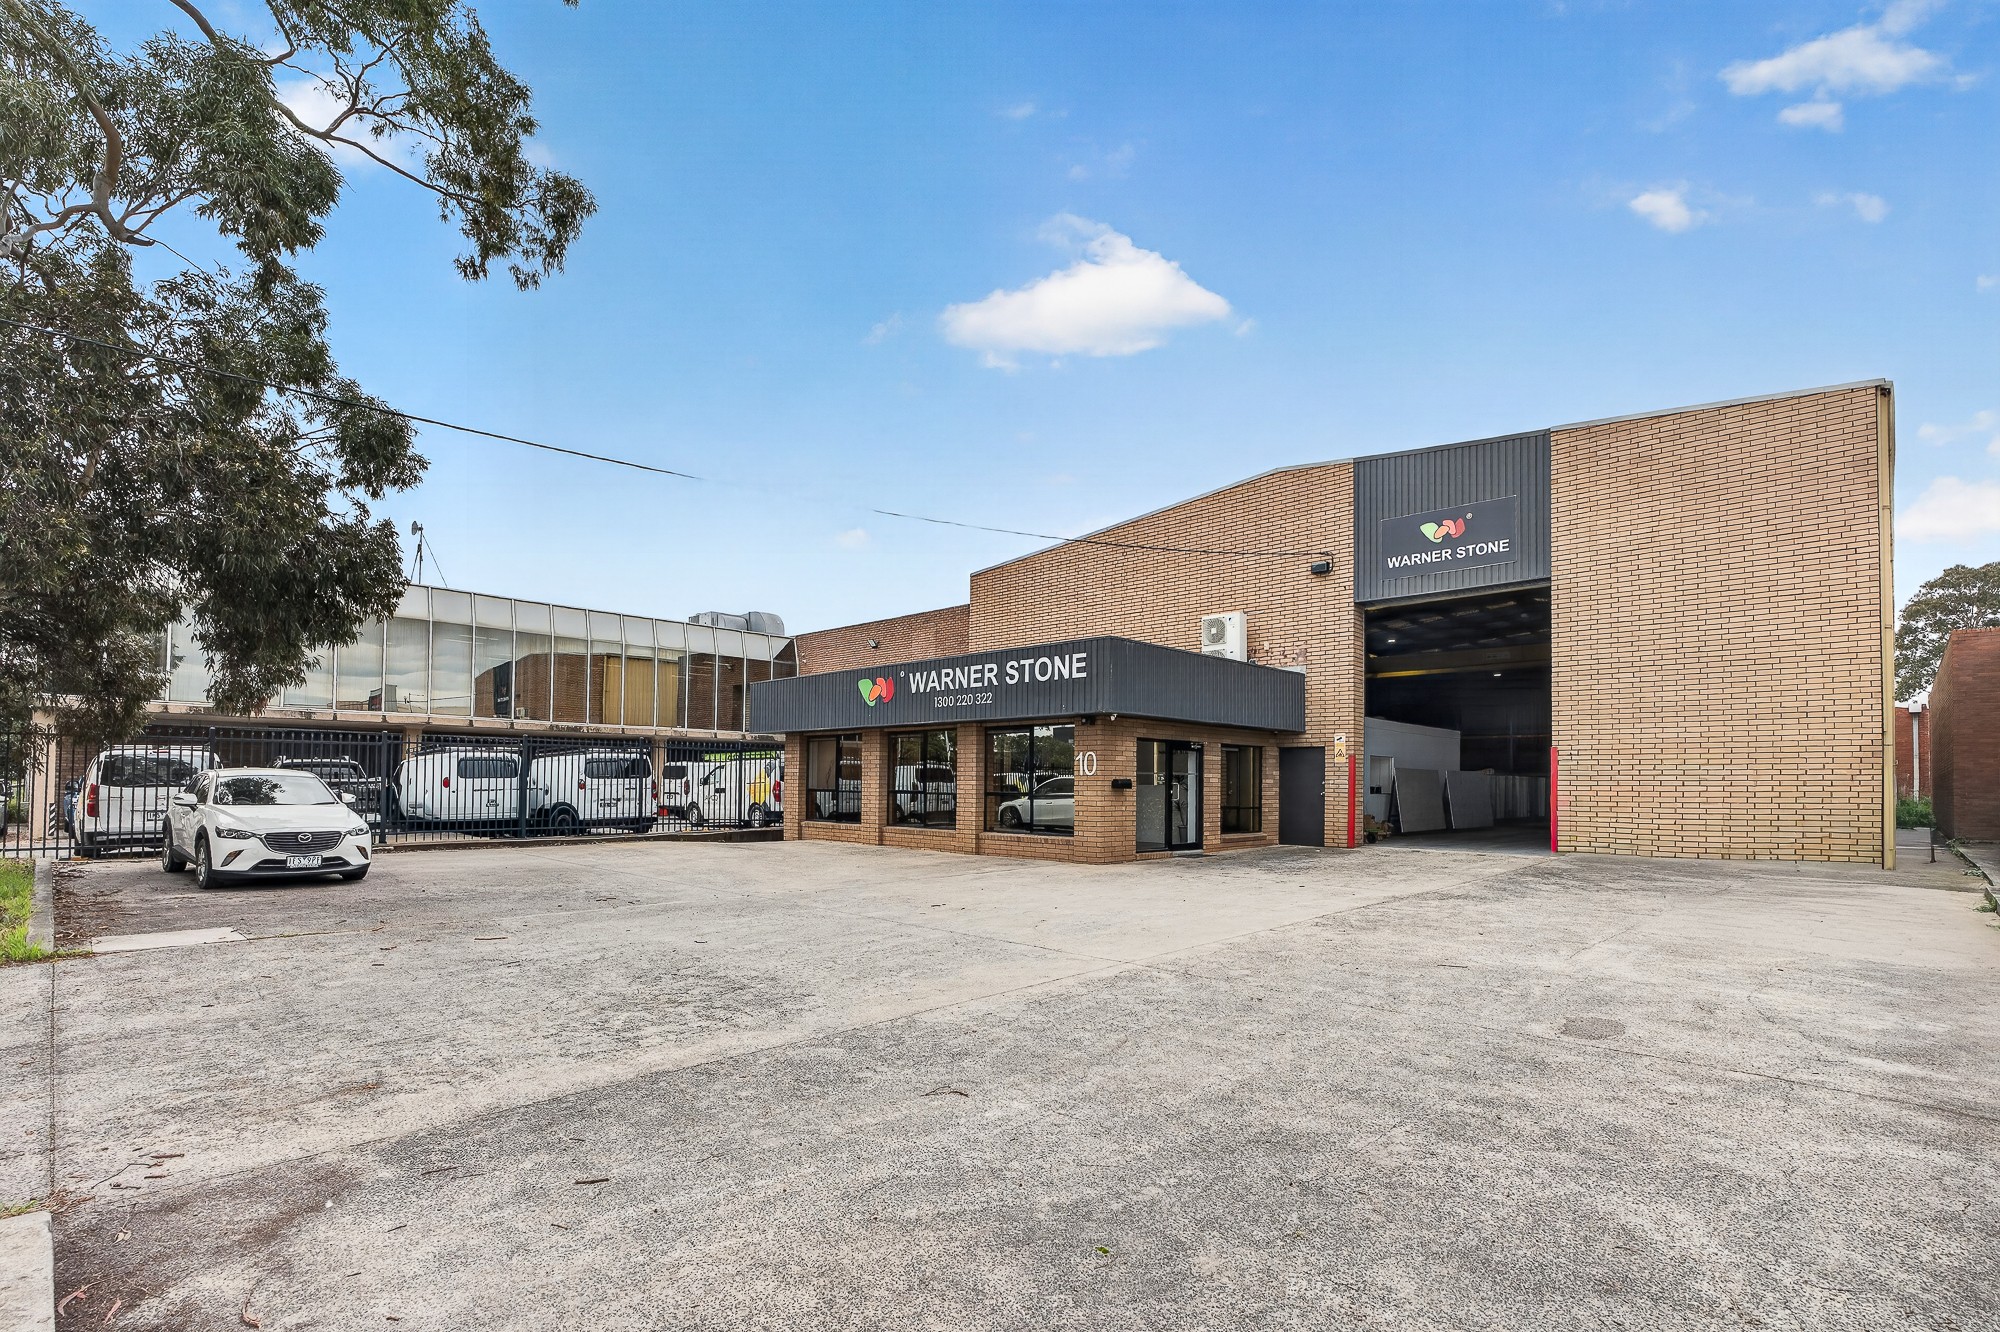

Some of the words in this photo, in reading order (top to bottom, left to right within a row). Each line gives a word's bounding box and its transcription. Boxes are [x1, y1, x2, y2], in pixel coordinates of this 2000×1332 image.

[1387, 548, 1452, 569] WARNER
[1456, 539, 1510, 558] STONE
[909, 663, 998, 694] WARNER
[1005, 652, 1087, 685] STONE
[934, 695, 954, 708] 1300
[956, 694, 974, 706] 220
[975, 692, 993, 705] 322
[1075, 751, 1097, 776] 10
